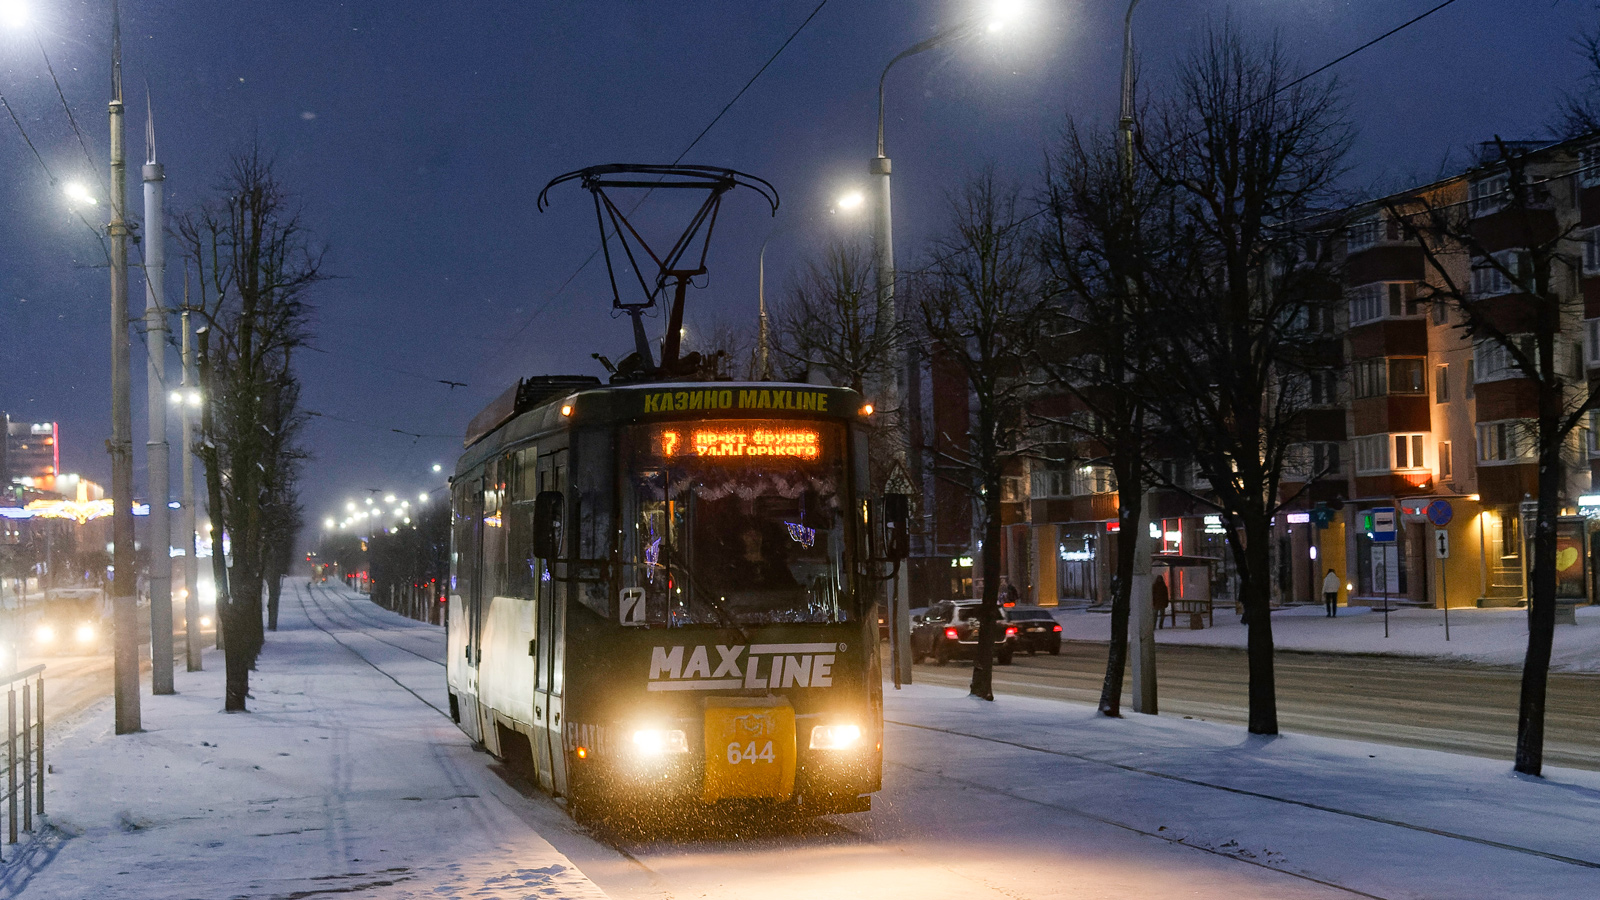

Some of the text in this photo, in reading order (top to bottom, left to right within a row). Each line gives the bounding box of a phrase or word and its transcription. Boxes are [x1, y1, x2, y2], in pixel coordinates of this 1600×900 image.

[644, 389, 828, 414] КАЗИНО MAXLINE
[664, 432, 677, 455] 7
[696, 430, 816, 444] пр-кт Фрунзе
[623, 591, 642, 623] 7
[727, 740, 776, 765] 644
